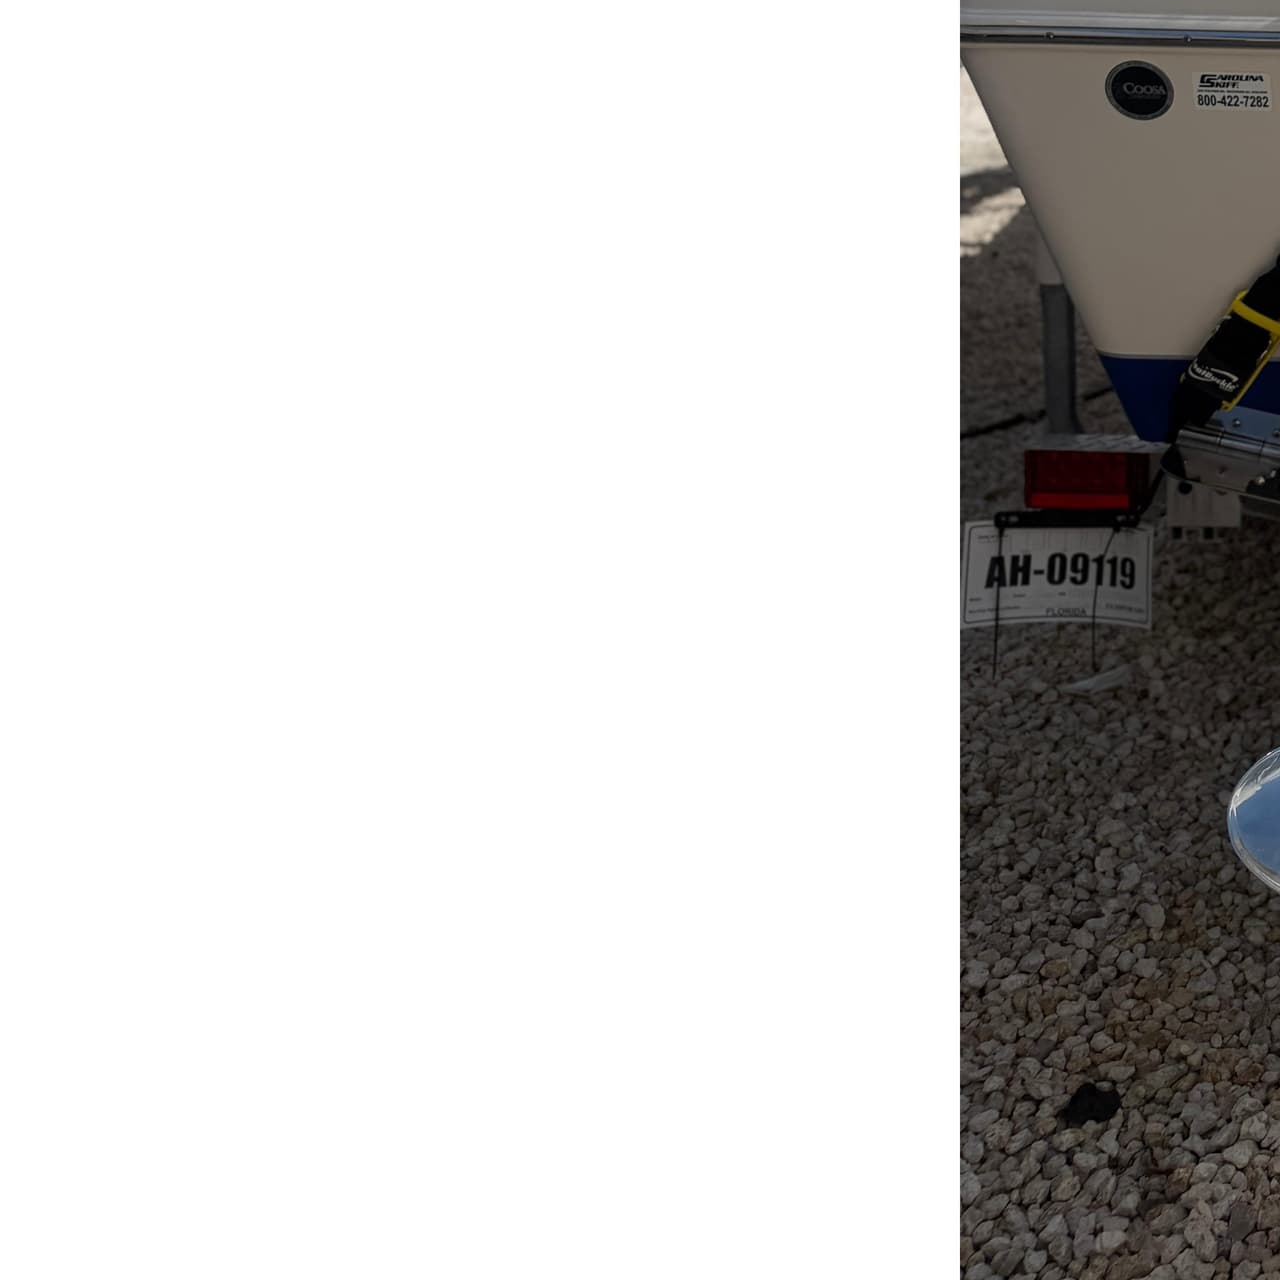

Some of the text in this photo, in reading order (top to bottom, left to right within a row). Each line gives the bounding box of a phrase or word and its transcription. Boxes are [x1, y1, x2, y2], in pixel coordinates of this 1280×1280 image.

[1200, 74, 1264, 83] CAROLINA
[1197, 94, 1270, 108] 800-422-7282
[984, 551, 1136, 590] AH-09119
[1045, 607, 1087, 617] FLORIDA
